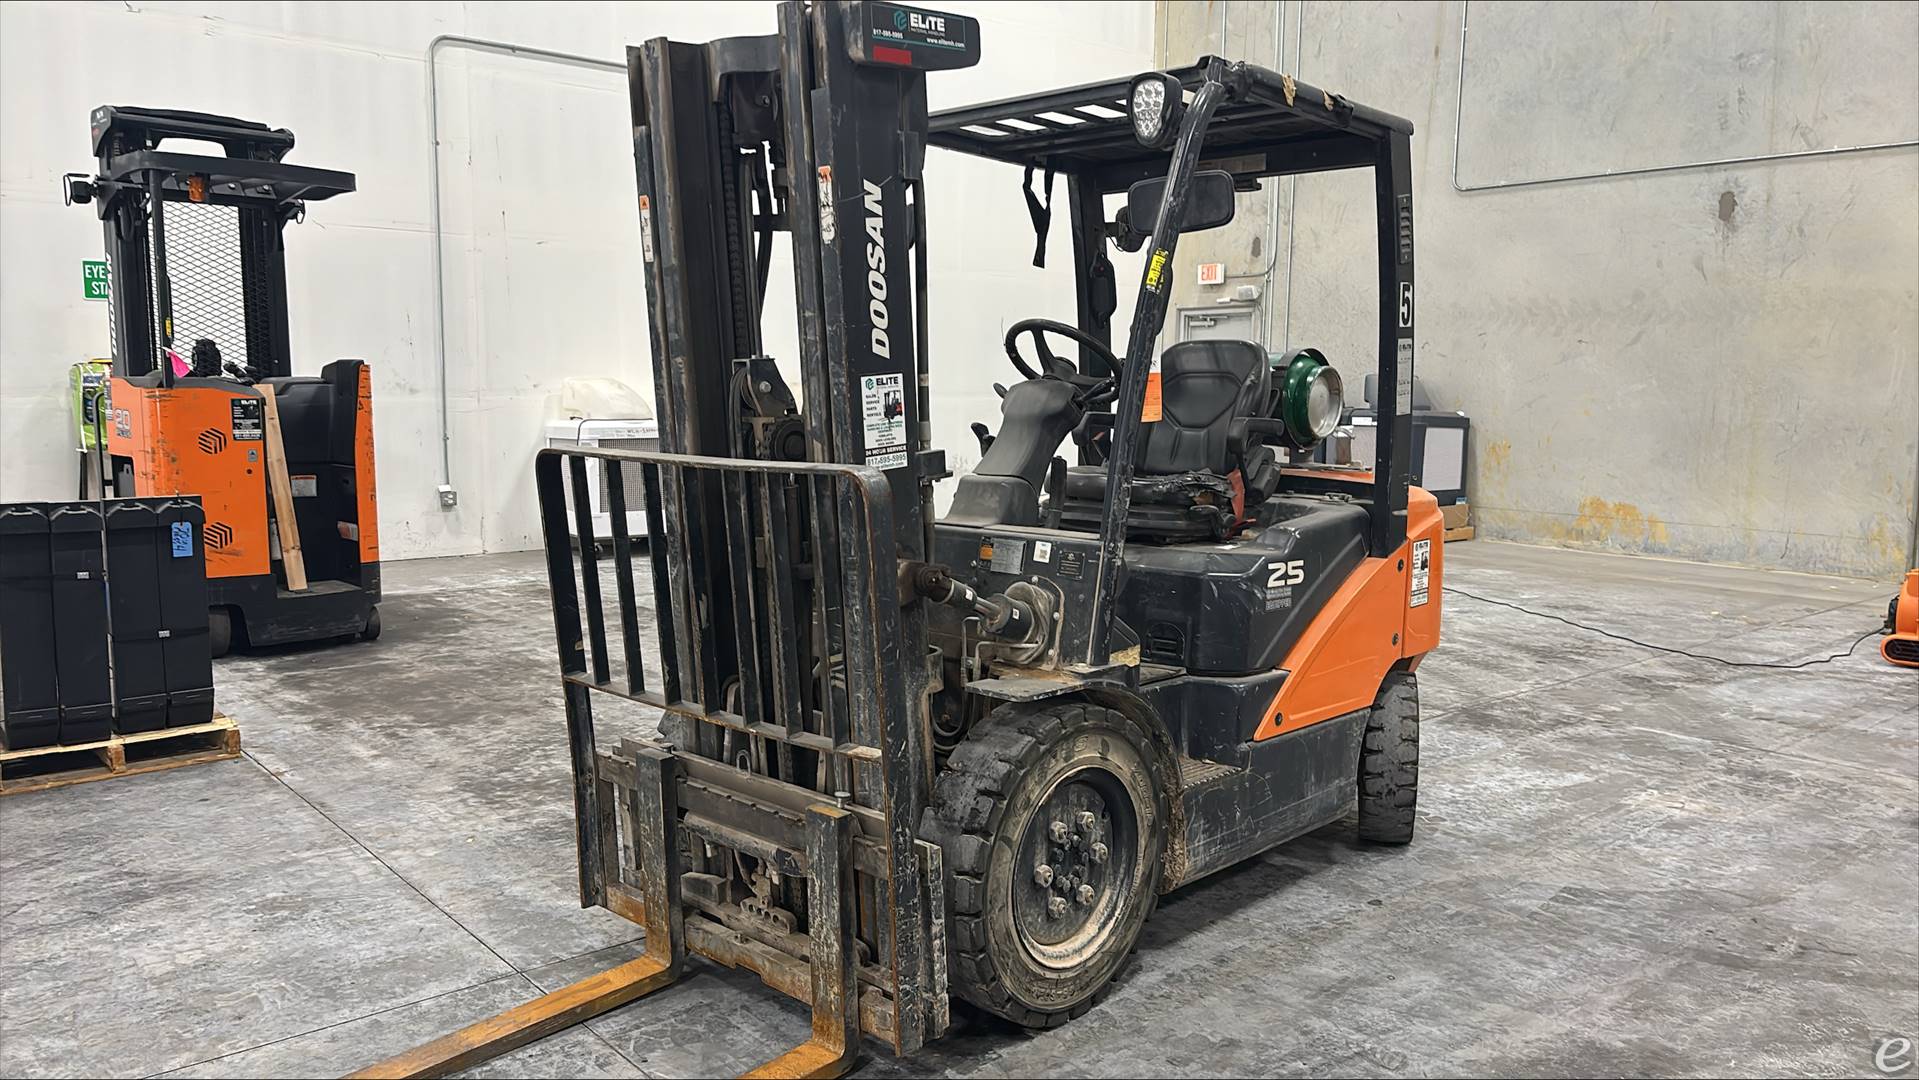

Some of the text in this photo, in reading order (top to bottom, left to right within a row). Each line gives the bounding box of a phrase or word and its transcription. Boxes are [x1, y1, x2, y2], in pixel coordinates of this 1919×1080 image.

[909, 12, 945, 32] ELITE
[84, 264, 106, 279] EYE
[863, 178, 891, 359] DOOSAN
[1201, 264, 1217, 281] EXIT
[1402, 284, 1410, 325] 5
[875, 376, 899, 386] ELITE
[872, 447, 886, 455] HOUR
[886, 445, 907, 453] SERVICE
[1267, 559, 1305, 588] 25
